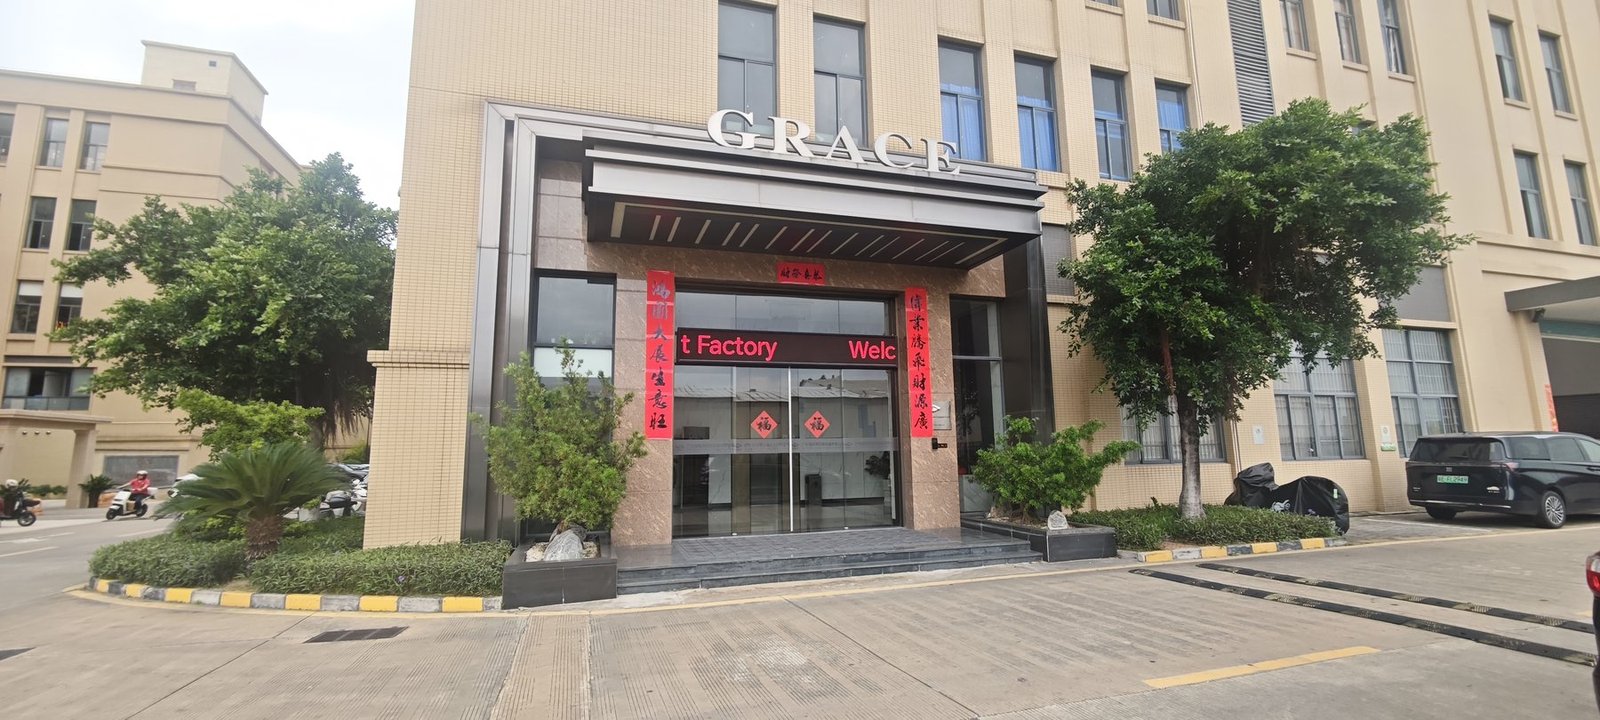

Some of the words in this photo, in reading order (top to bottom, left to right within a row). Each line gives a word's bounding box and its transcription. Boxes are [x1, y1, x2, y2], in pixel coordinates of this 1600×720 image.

[707, 109, 961, 176] GRACE
[680, 334, 691, 354] t
[697, 334, 778, 362] Factory
[848, 340, 897, 360] Welc
[756, 416, 772, 431] 福
[810, 416, 825, 431] 福
